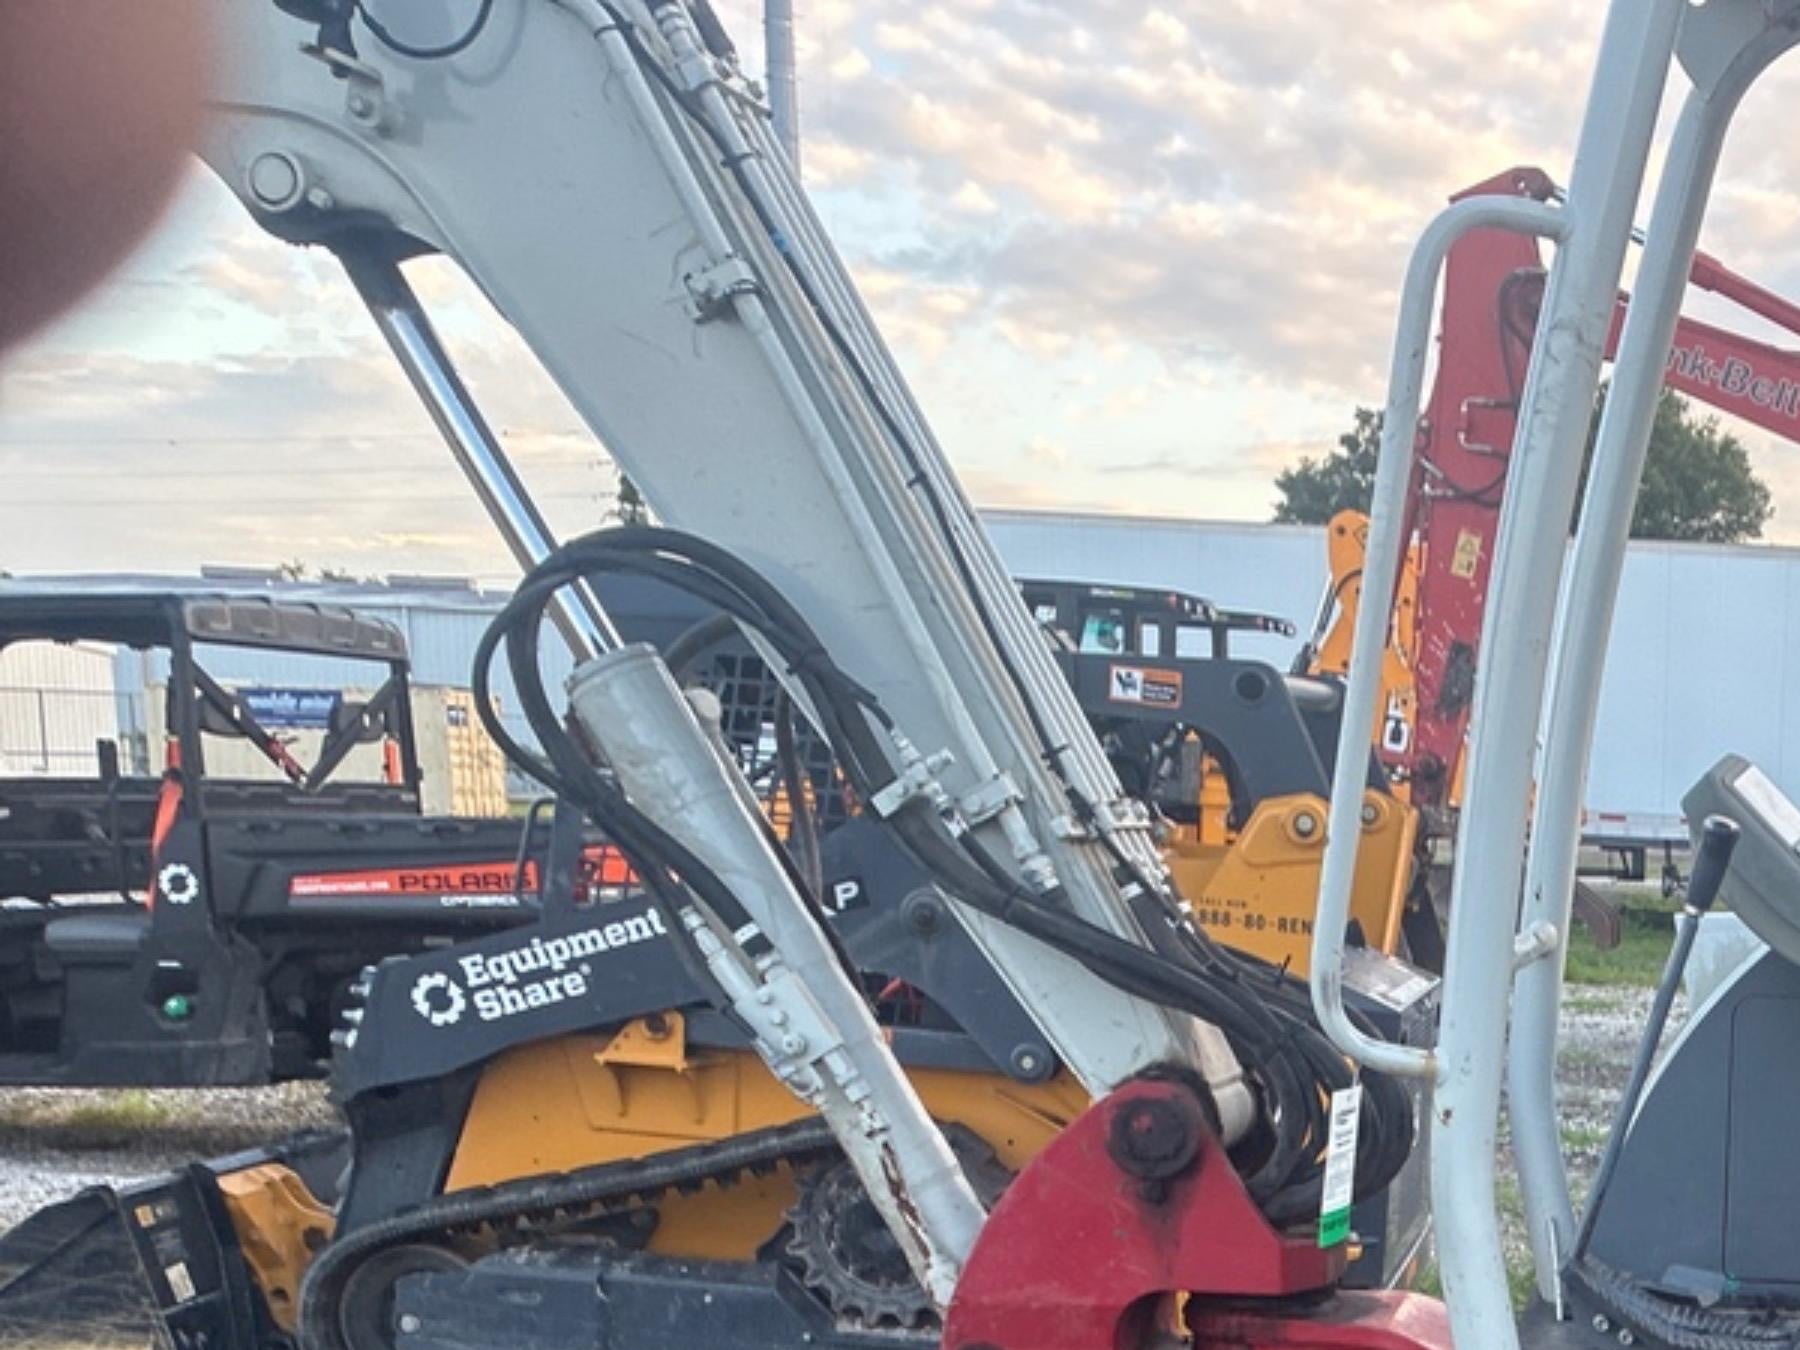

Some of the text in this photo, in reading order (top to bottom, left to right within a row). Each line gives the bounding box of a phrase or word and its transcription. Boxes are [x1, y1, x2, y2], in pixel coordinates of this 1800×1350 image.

[399, 869, 533, 891] POLARIS
[458, 906, 667, 987] Equipment
[473, 970, 588, 1022] Share
